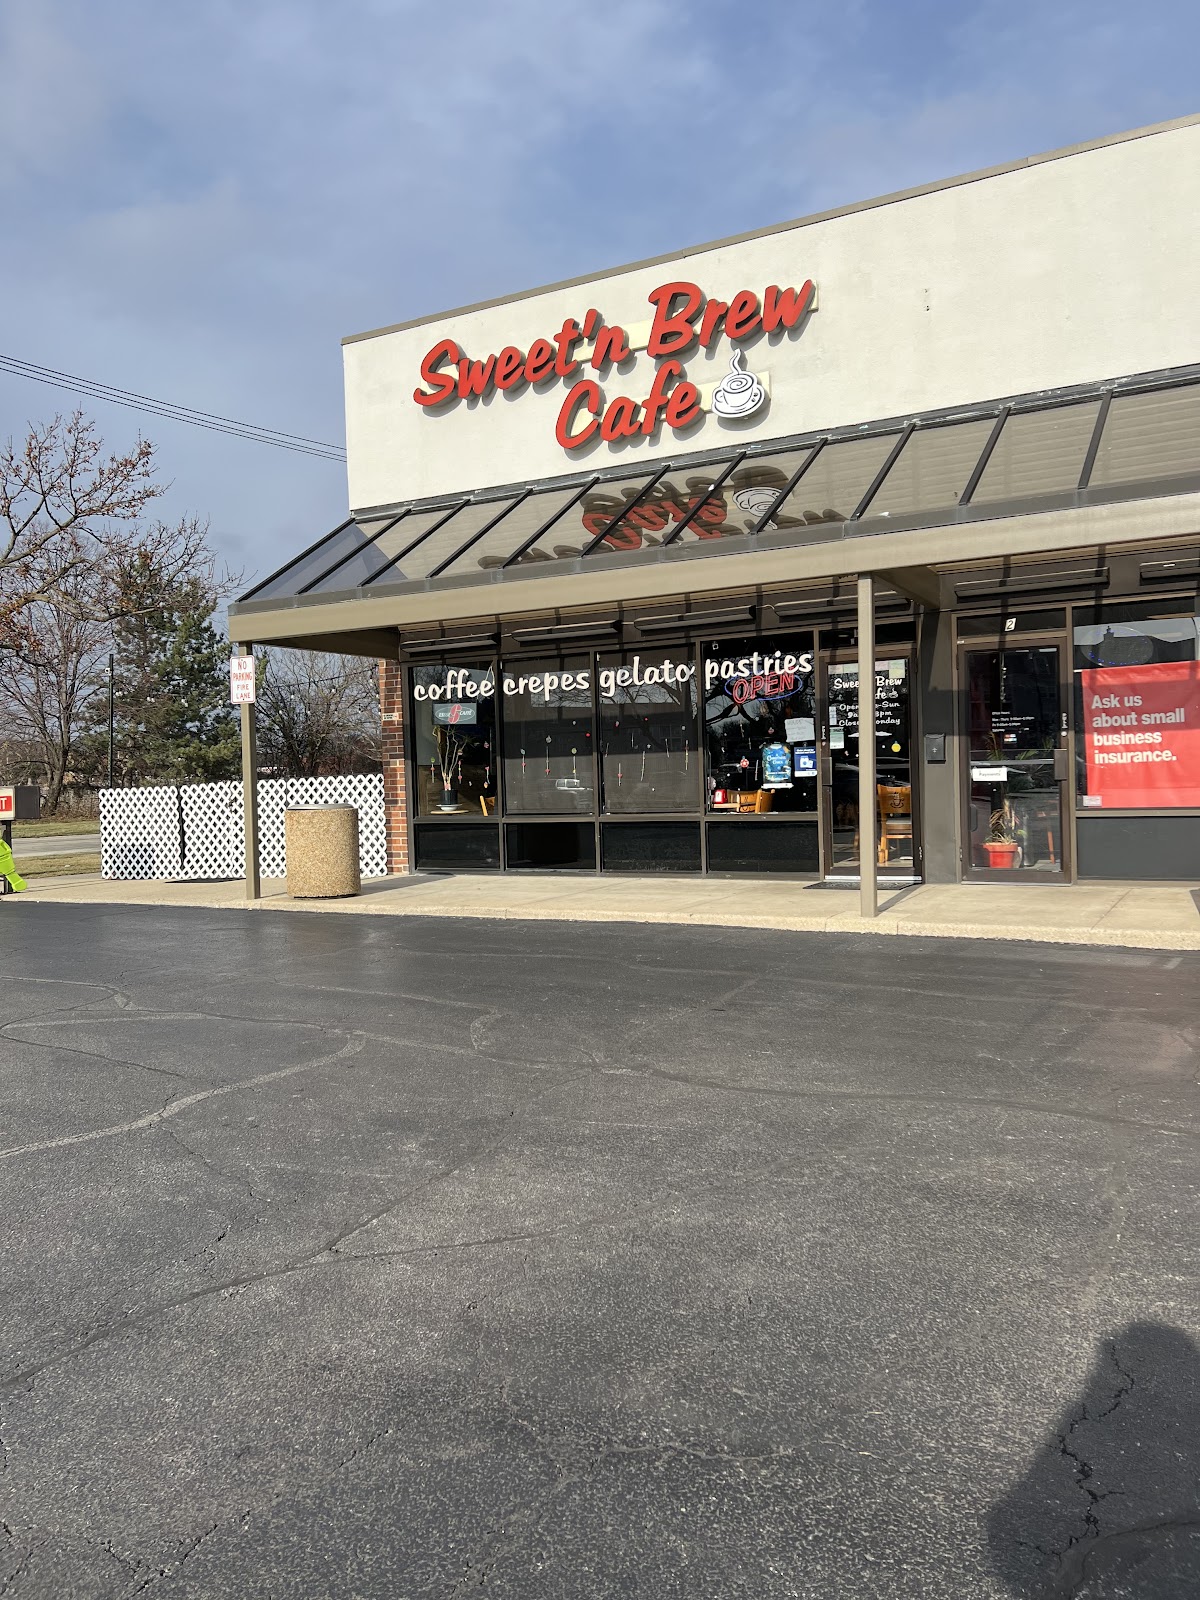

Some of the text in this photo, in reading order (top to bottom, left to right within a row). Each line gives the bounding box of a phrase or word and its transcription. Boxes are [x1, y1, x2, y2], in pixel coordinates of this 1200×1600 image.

[413, 279, 813, 407] Sweet'n Brew
[555, 360, 704, 450] Cafe
[1006, 619, 1014, 630] 2
[237, 660, 247, 670] NO
[233, 672, 252, 681] PARKING
[414, 650, 813, 702] coffee crepes gelato pastries
[833, 676, 902, 689] Swee Brew
[236, 683, 249, 691] FIRE
[732, 671, 795, 704] OPEN
[1091, 694, 1142, 709] Ask us
[875, 717, 900, 726] onday
[1092, 708, 1185, 728] about small
[1092, 731, 1162, 746] business
[1094, 750, 1177, 764] insurance.
